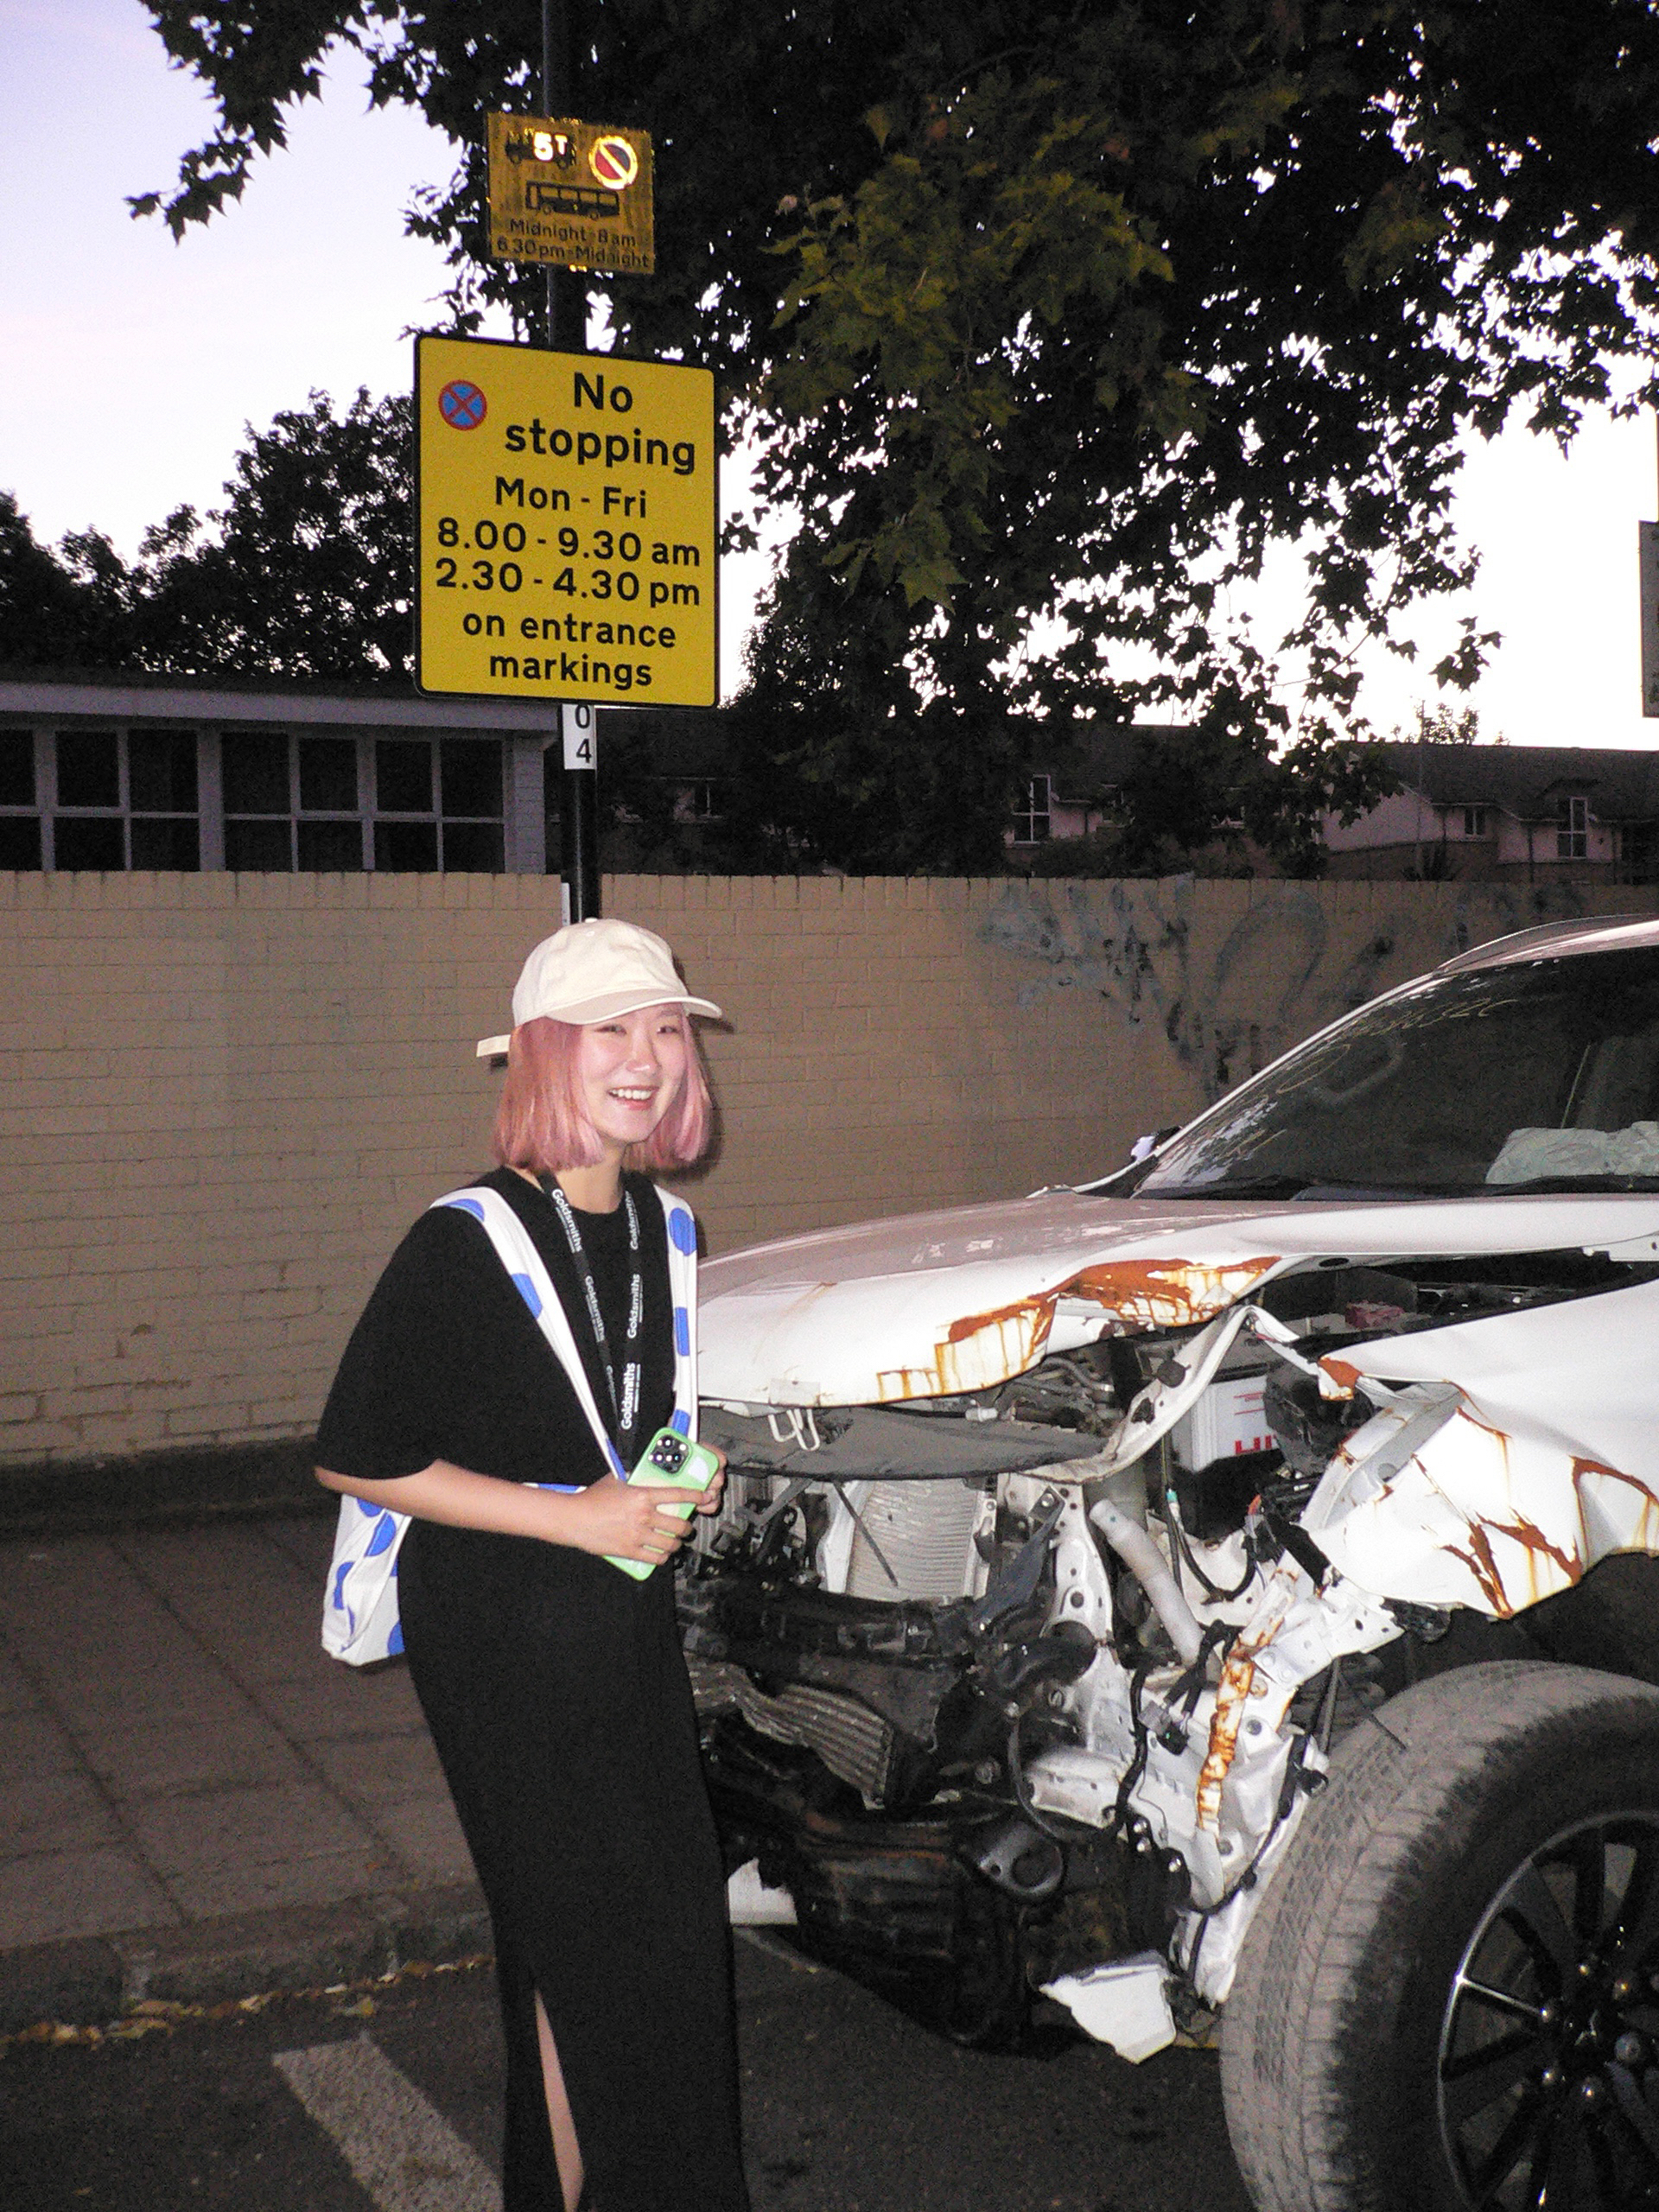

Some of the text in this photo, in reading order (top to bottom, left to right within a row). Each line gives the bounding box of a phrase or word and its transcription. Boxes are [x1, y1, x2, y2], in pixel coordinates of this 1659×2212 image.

[573, 371, 634, 414] No
[504, 418, 696, 477] stopping
[495, 475, 571, 512] Mon
[602, 486, 647, 518] Fri
[437, 516, 527, 553] 8.00
[557, 526, 642, 563] 9.30
[651, 542, 701, 568] am
[435, 556, 524, 594] 2.30
[552, 567, 642, 602] 4.30
[650, 582, 700, 609] pm
[462, 613, 677, 649] on entrance
[489, 652, 652, 691] markings
[552, 1188, 583, 1253] Goldsmiths
[626, 1274, 640, 1339] Goldsmiths
[620, 1363, 637, 1430] Goldsmiths
